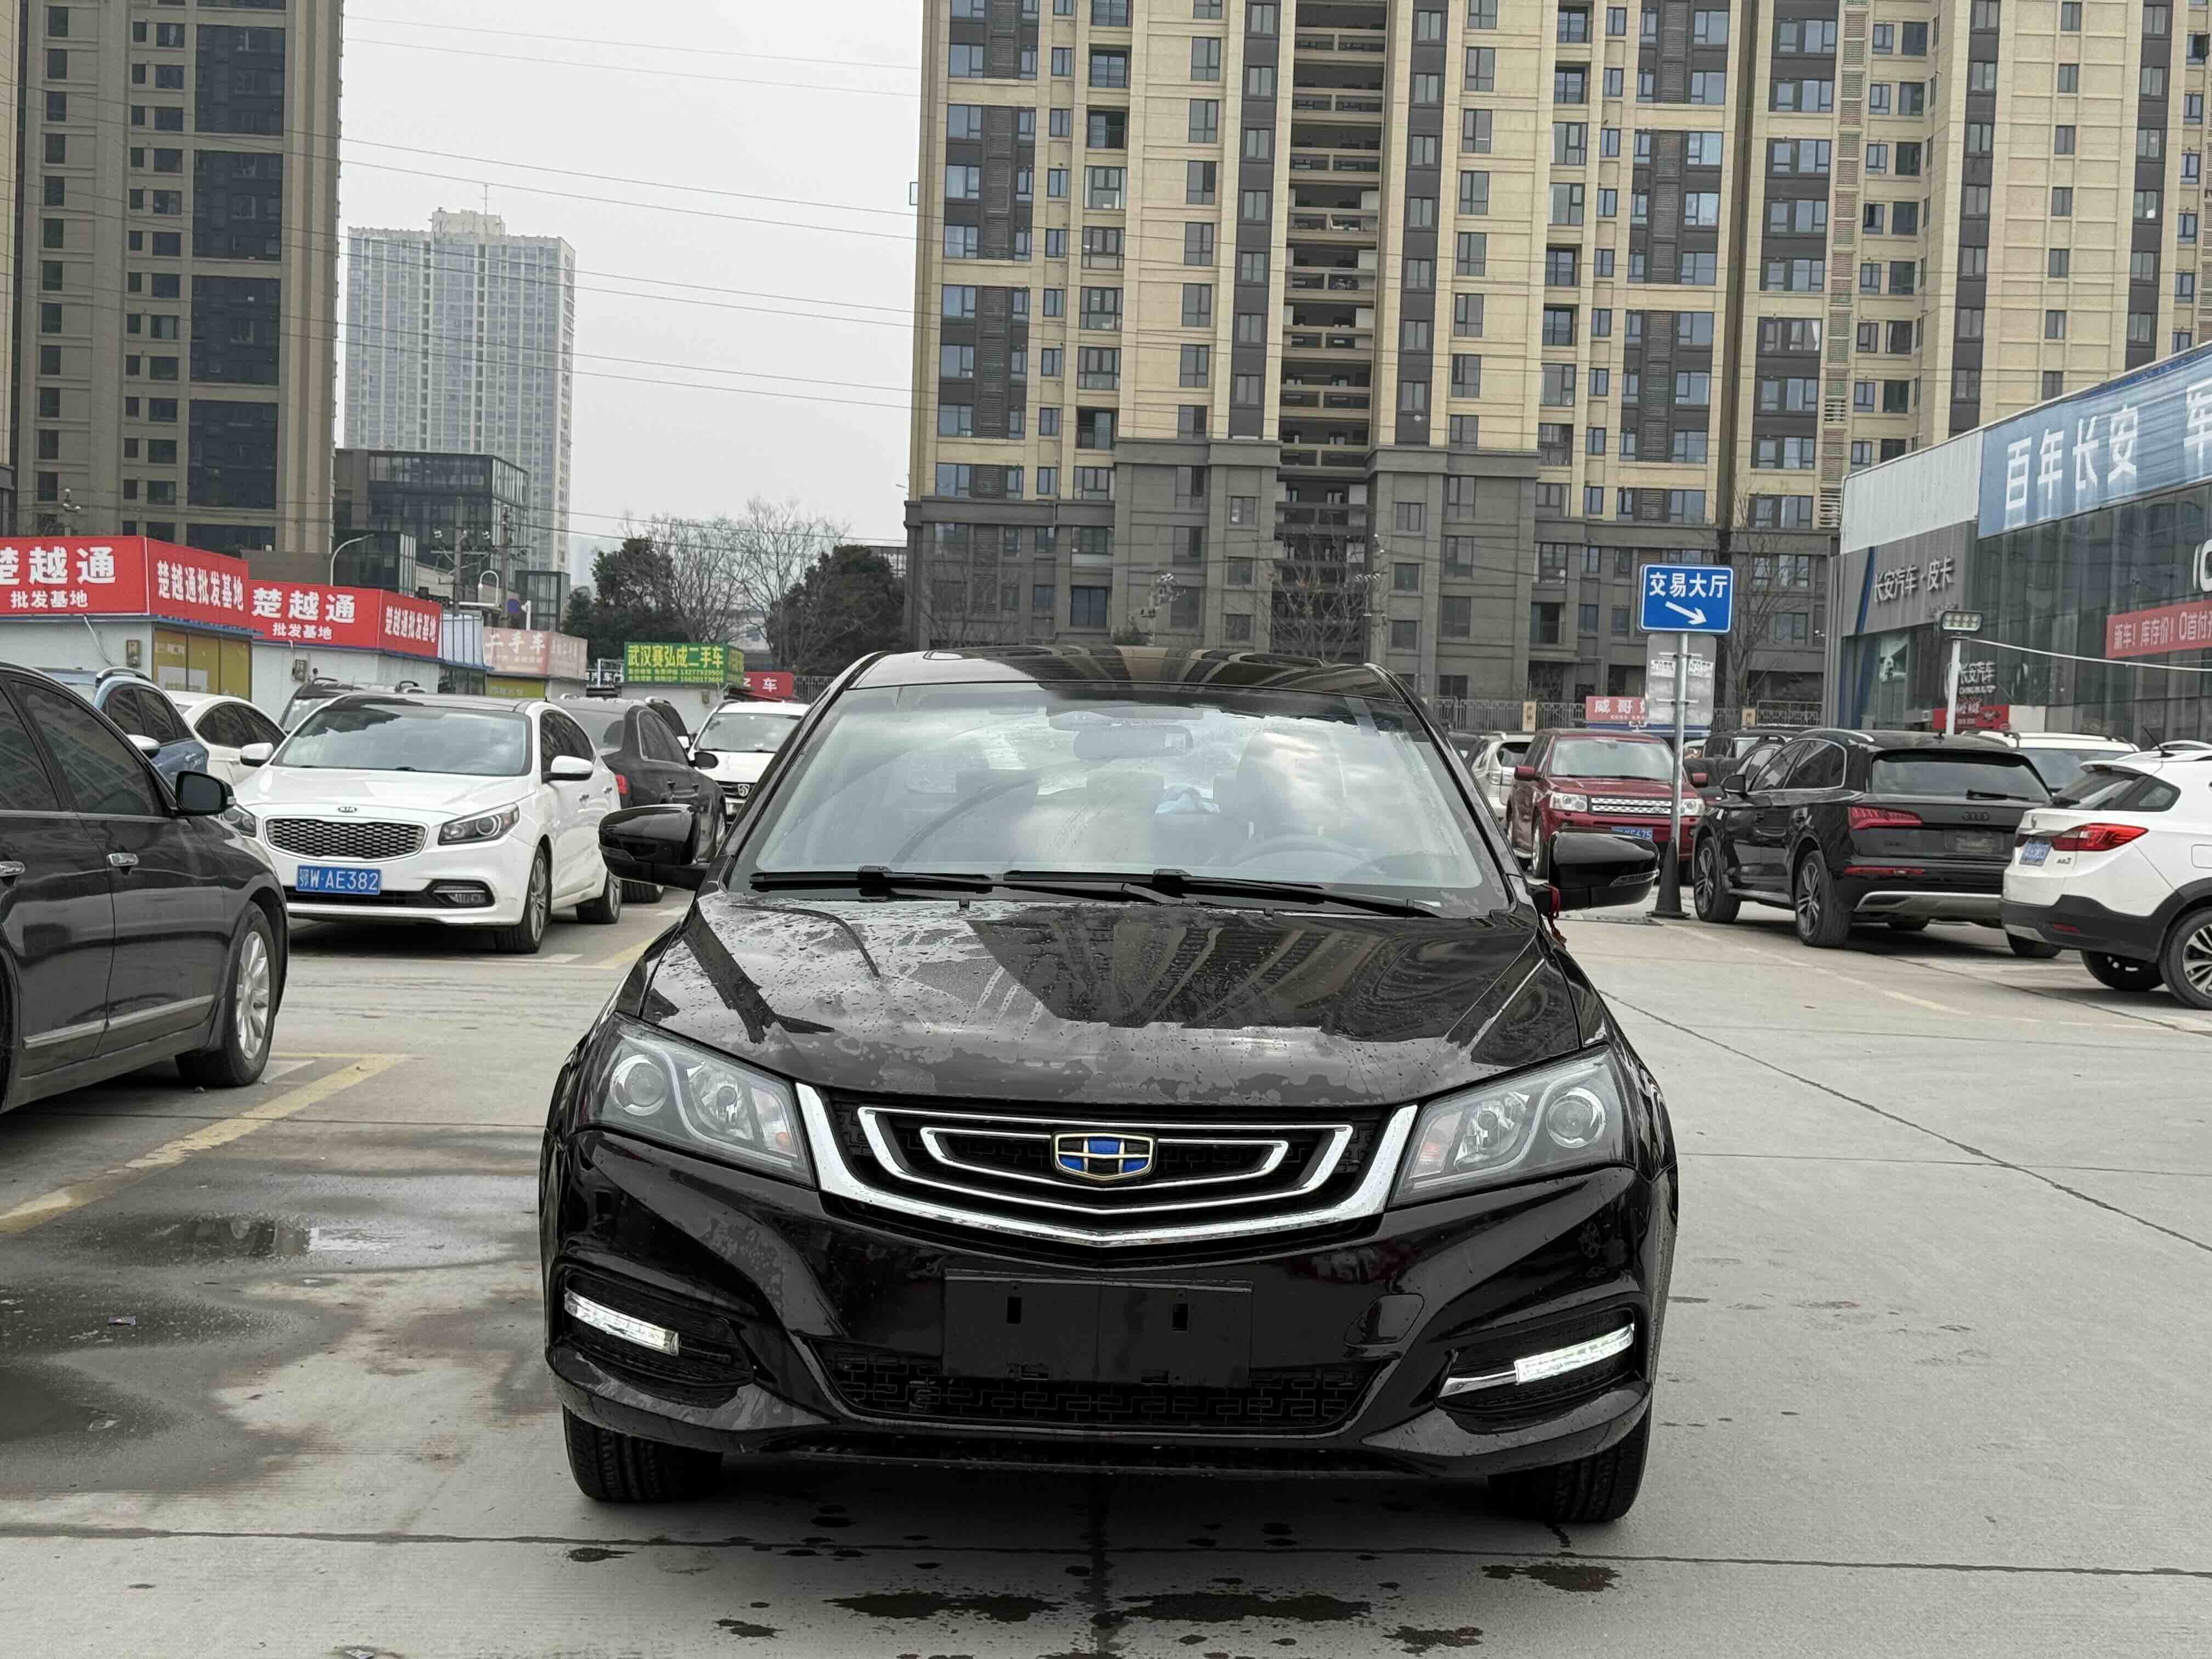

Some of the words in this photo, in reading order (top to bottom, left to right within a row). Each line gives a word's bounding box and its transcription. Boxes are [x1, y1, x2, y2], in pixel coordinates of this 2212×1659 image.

[2005, 404, 2138, 510] 百年长安
[10, 589, 88, 609] 批发基地
[157, 560, 244, 611] 楚越通批发基地
[1649, 572, 1728, 598] 交易大厅
[251, 587, 356, 624] 楚越通
[385, 605, 437, 643] 楚越通批发基地
[272, 622, 332, 640] 批发基地
